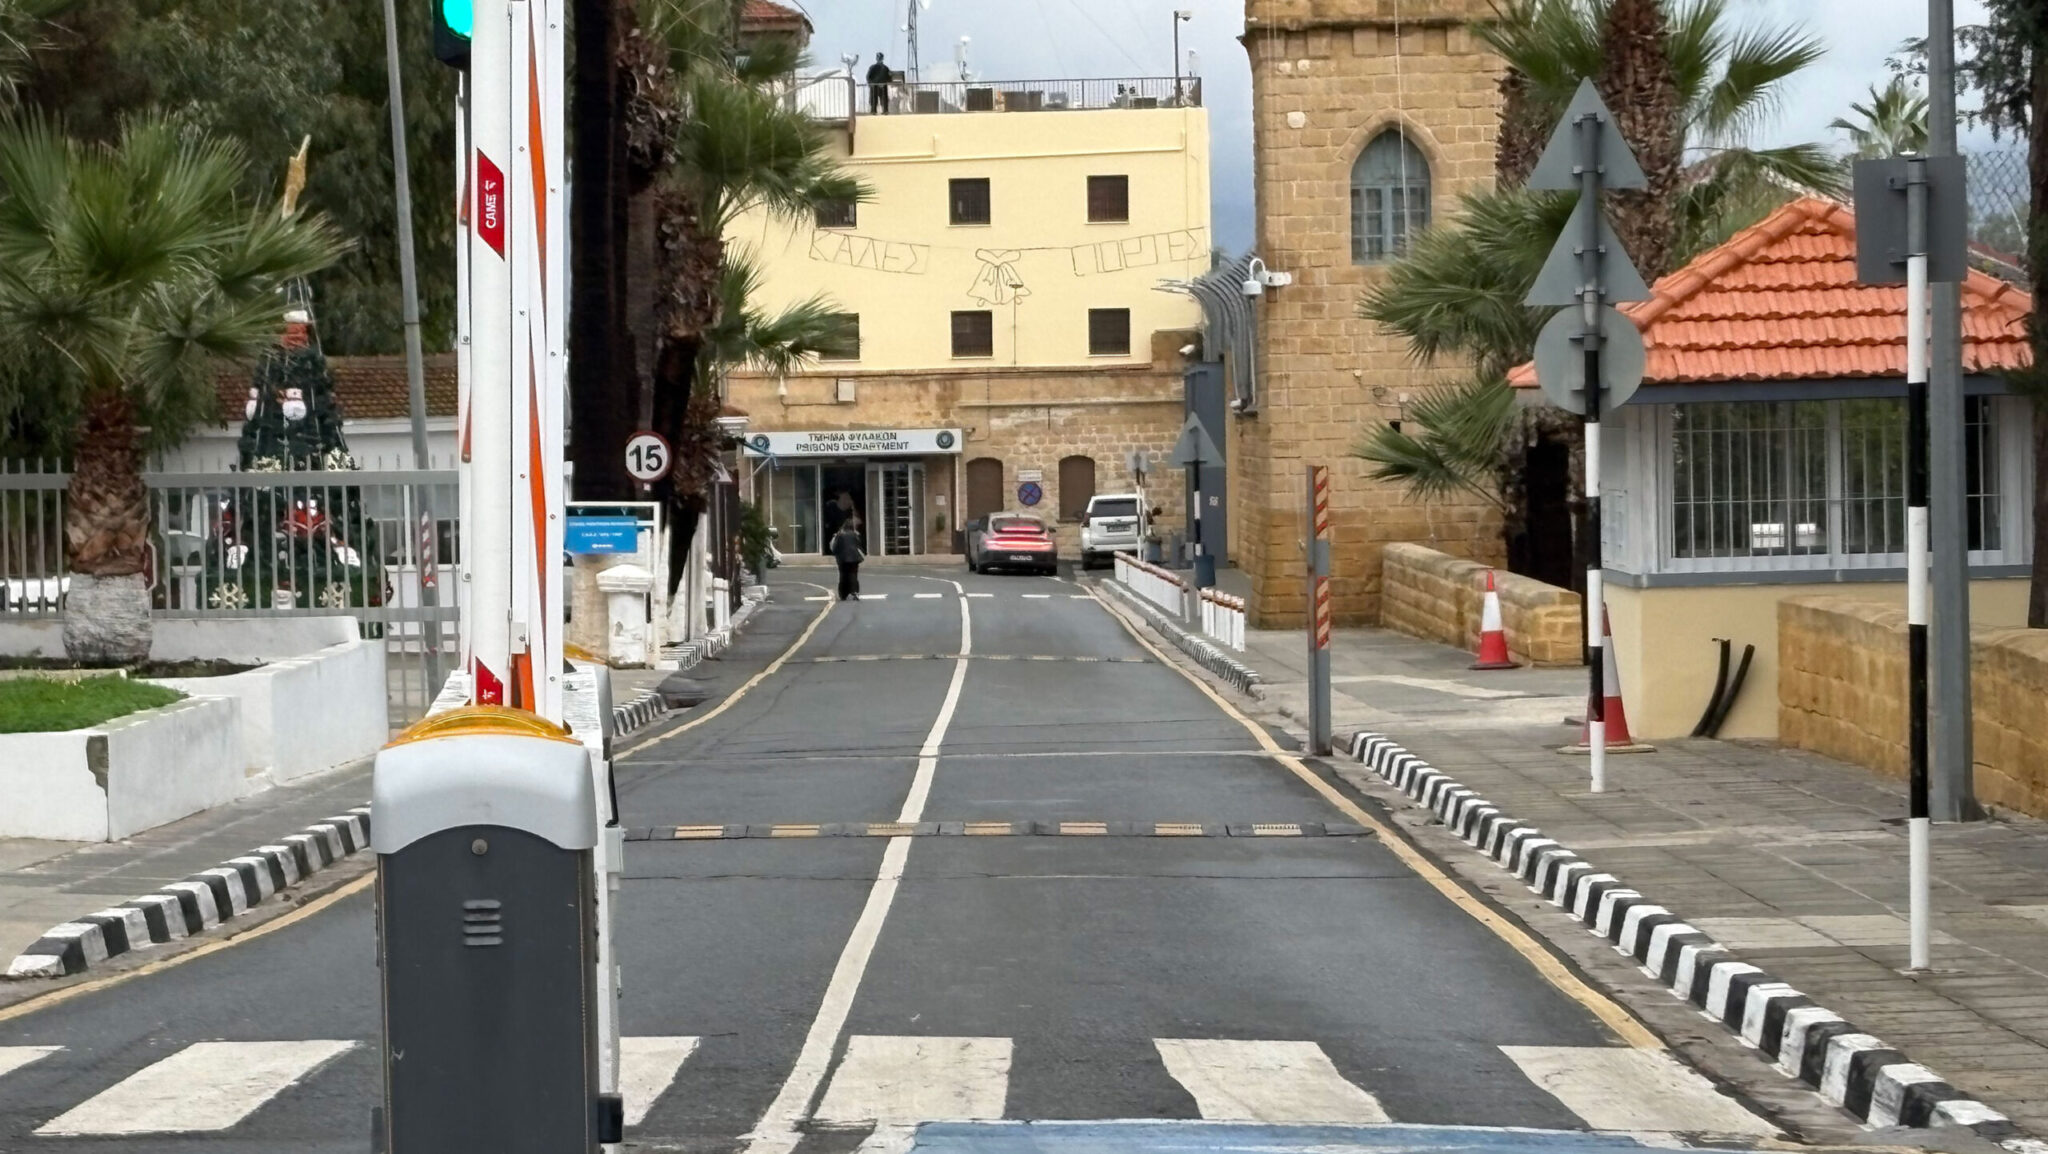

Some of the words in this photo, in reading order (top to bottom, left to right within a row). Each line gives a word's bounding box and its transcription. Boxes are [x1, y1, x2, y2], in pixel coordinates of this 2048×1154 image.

[485, 193, 497, 229] CAME
[808, 228, 931, 275] ΚΑΛΕΣ
[796, 442, 840, 452] PRISONS
[843, 441, 910, 451] DEPARTMENT
[808, 433, 846, 442] ΤΜΗΜΑ
[628, 444, 663, 473] 15
